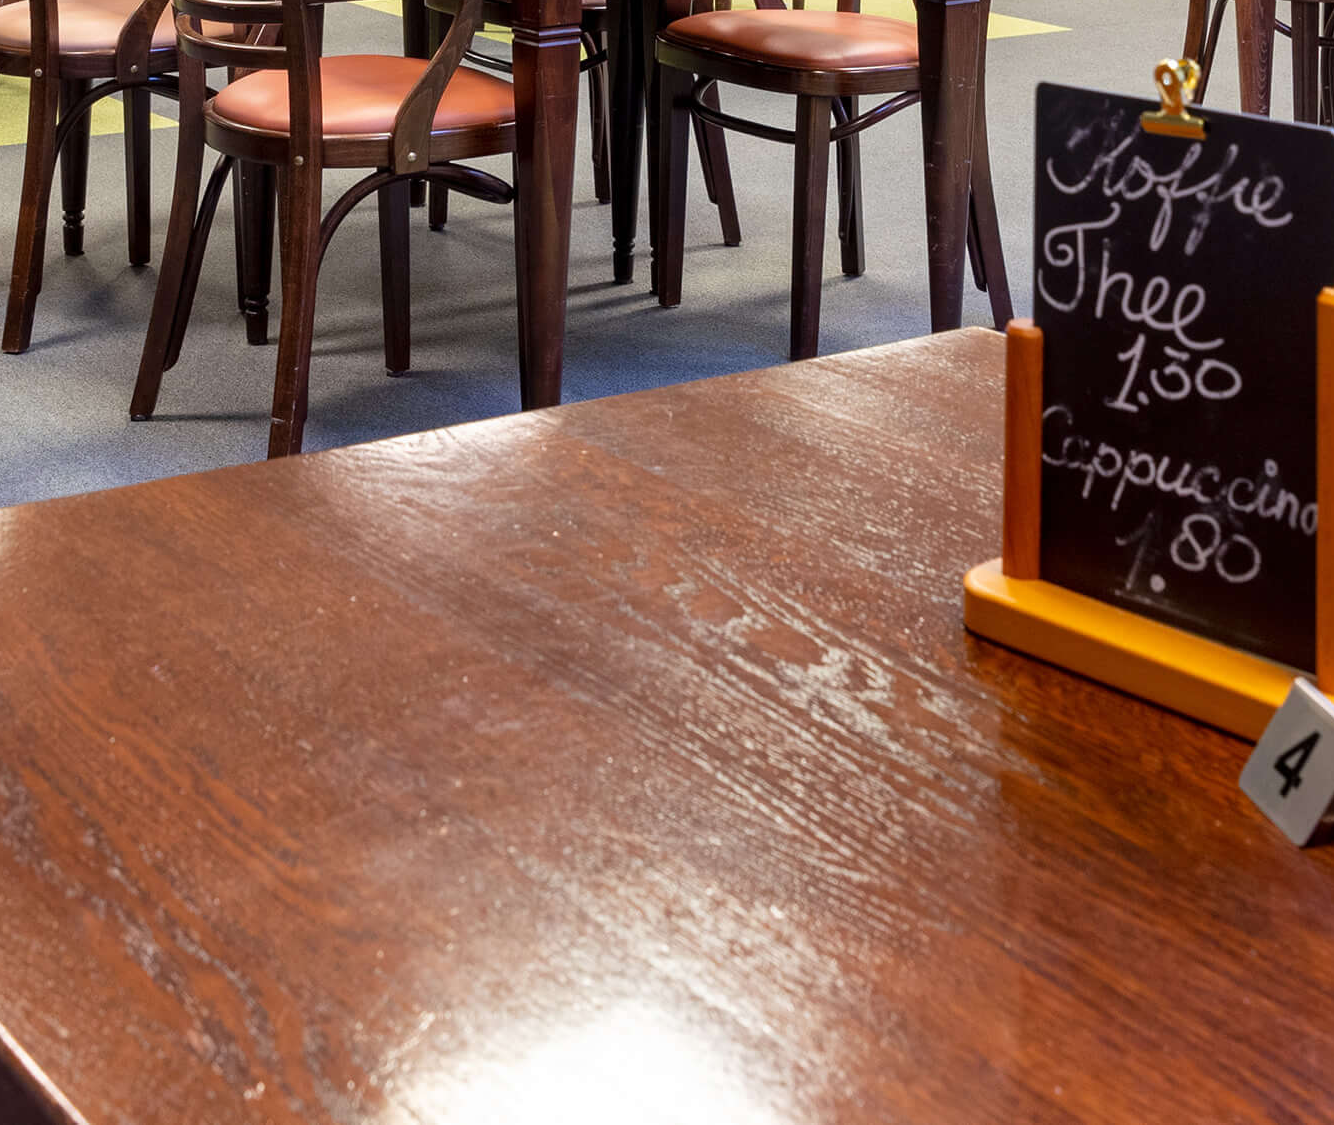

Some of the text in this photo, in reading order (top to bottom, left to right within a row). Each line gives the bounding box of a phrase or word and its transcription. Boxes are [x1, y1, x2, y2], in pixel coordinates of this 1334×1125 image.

[1045, 115, 1294, 255] Koffie
[1037, 201, 1225, 350] Thee
[1104, 333, 1243, 413] 1.50
[1114, 512, 1262, 599] 1.80
[1273, 731, 1322, 799] 4
